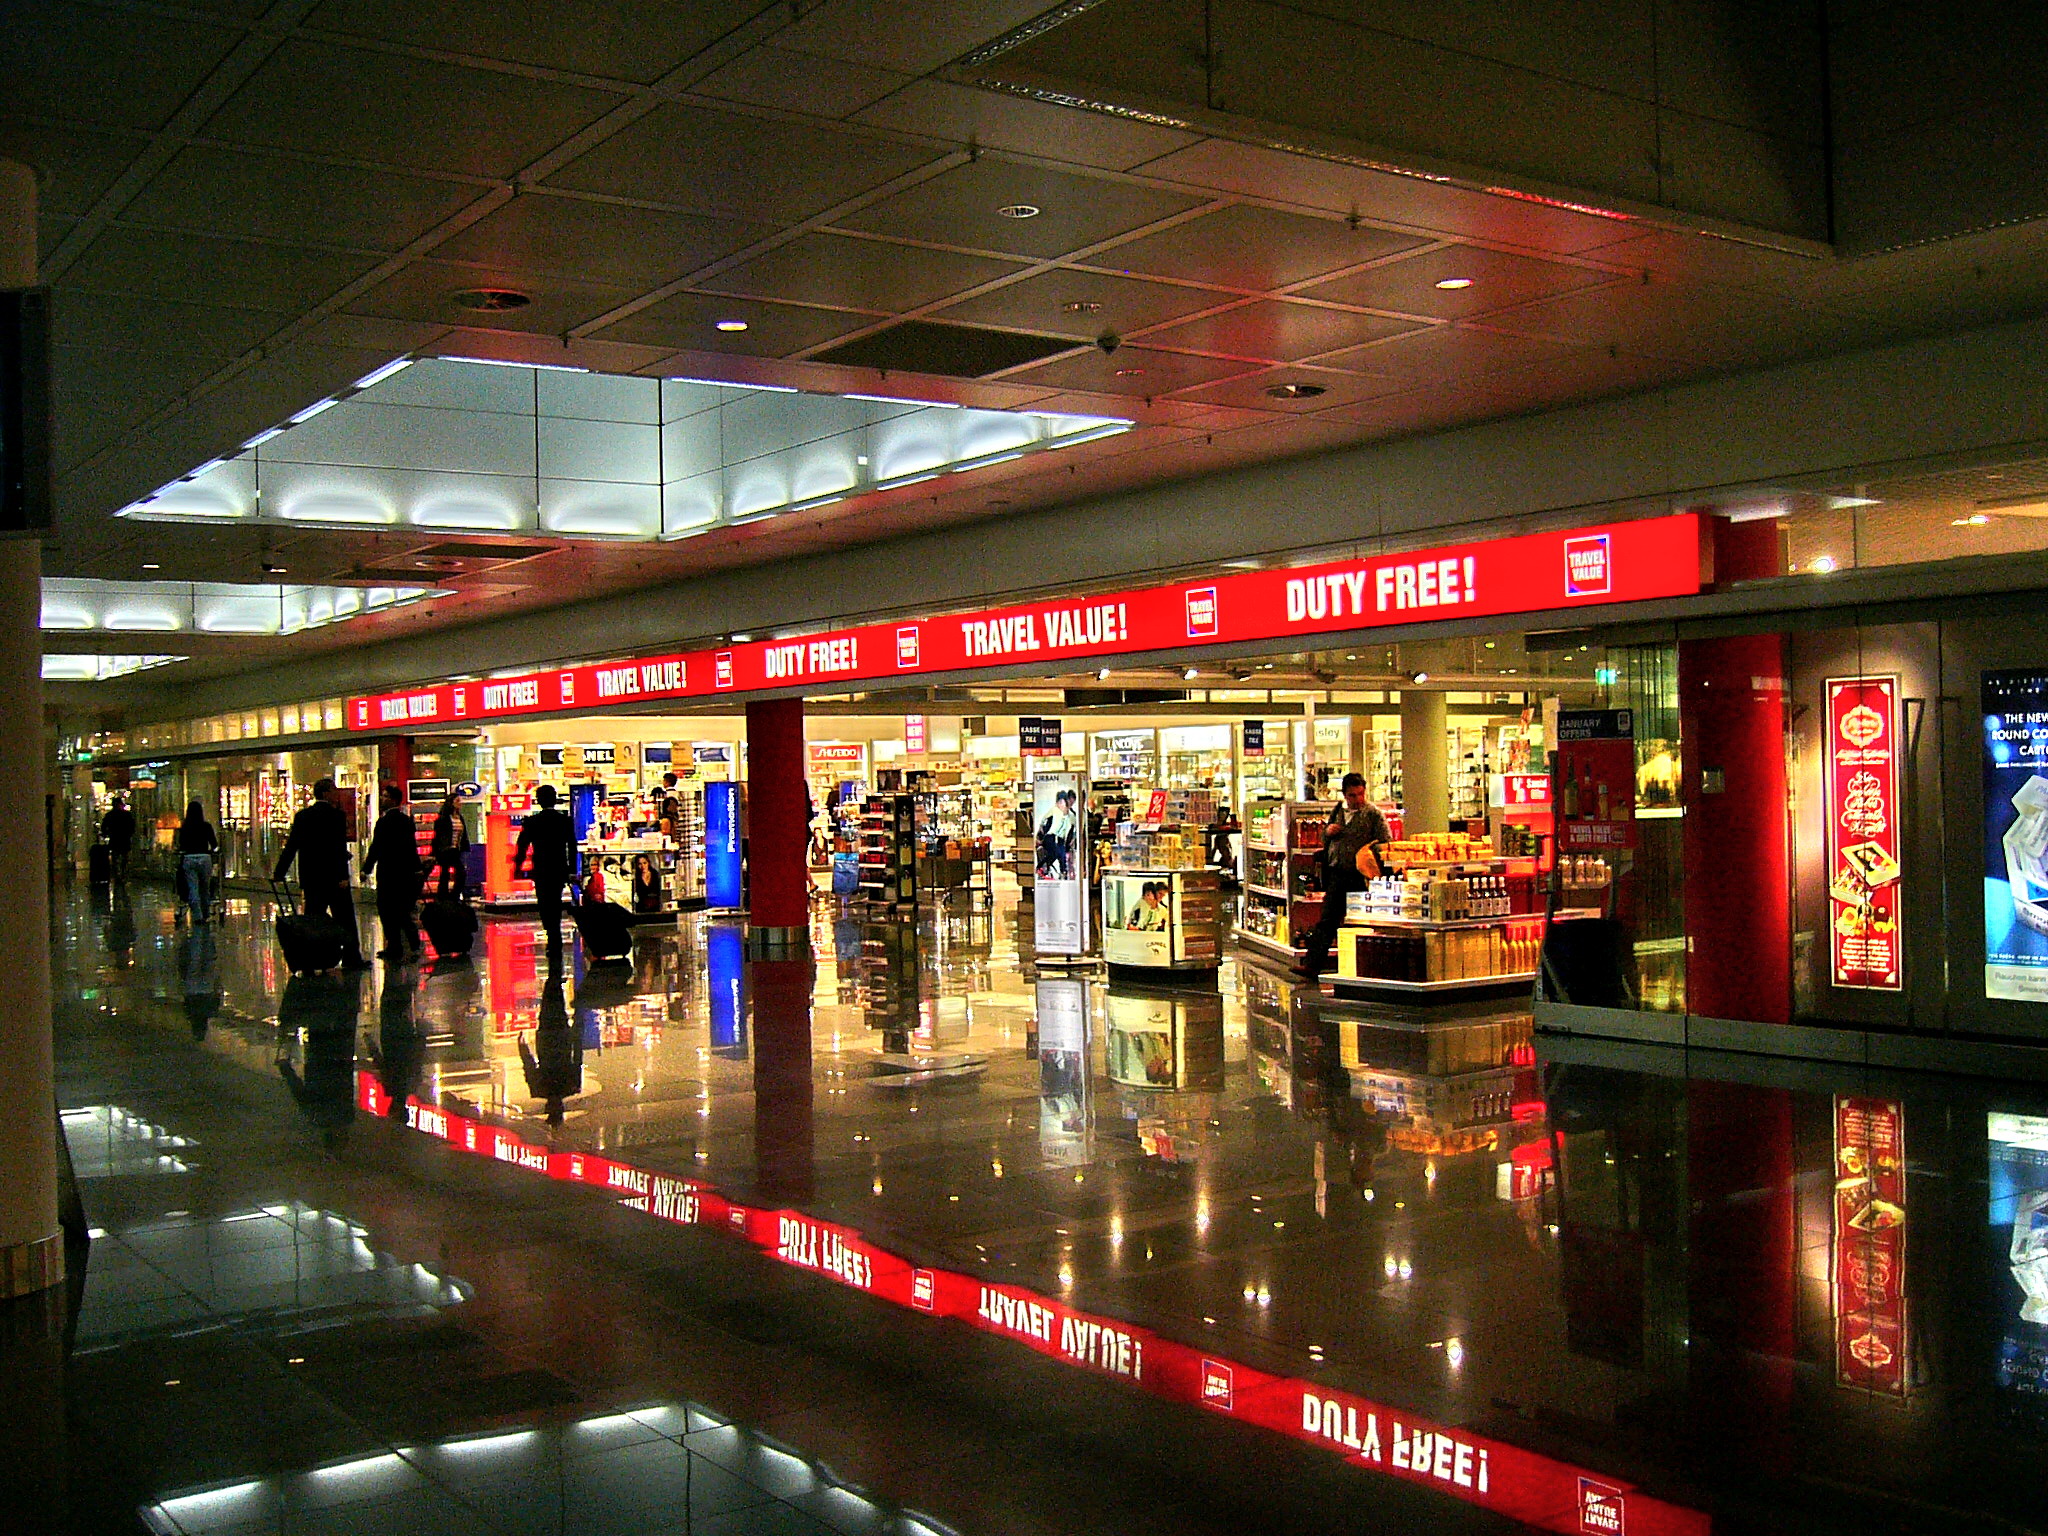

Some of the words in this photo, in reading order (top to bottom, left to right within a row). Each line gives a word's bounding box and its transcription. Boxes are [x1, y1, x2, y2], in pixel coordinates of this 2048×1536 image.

[1568, 549, 1606, 568] TRAVEL
[1572, 565, 1604, 581] VALUE
[1286, 570, 1367, 622] DUTY
[1375, 556, 1475, 612] FREE!
[962, 614, 1040, 657] TRAVEL
[1044, 602, 1128, 649] VALUE!
[765, 644, 806, 679] DUTY
[808, 637, 858, 674] FREE!
[596, 667, 641, 697] TRAVEL
[641, 661, 687, 692] VALUE!
[483, 684, 508, 710] DUTY
[508, 680, 539, 708] FREE!
[381, 697, 409, 721] TRAVEL
[408, 694, 438, 718] VALUE!
[1560, 718, 1600, 729] JANUARY
[2005, 713, 2023, 723] THE
[1992, 730, 2030, 741] ROUND
[558, 750, 614, 763] CANEL
[816, 748, 857, 758] SHISEIDO
[1035, 774, 1060, 782] URBAN
[727, 787, 736, 853] Promotion
[1146, 941, 1167, 949] CAMEL
